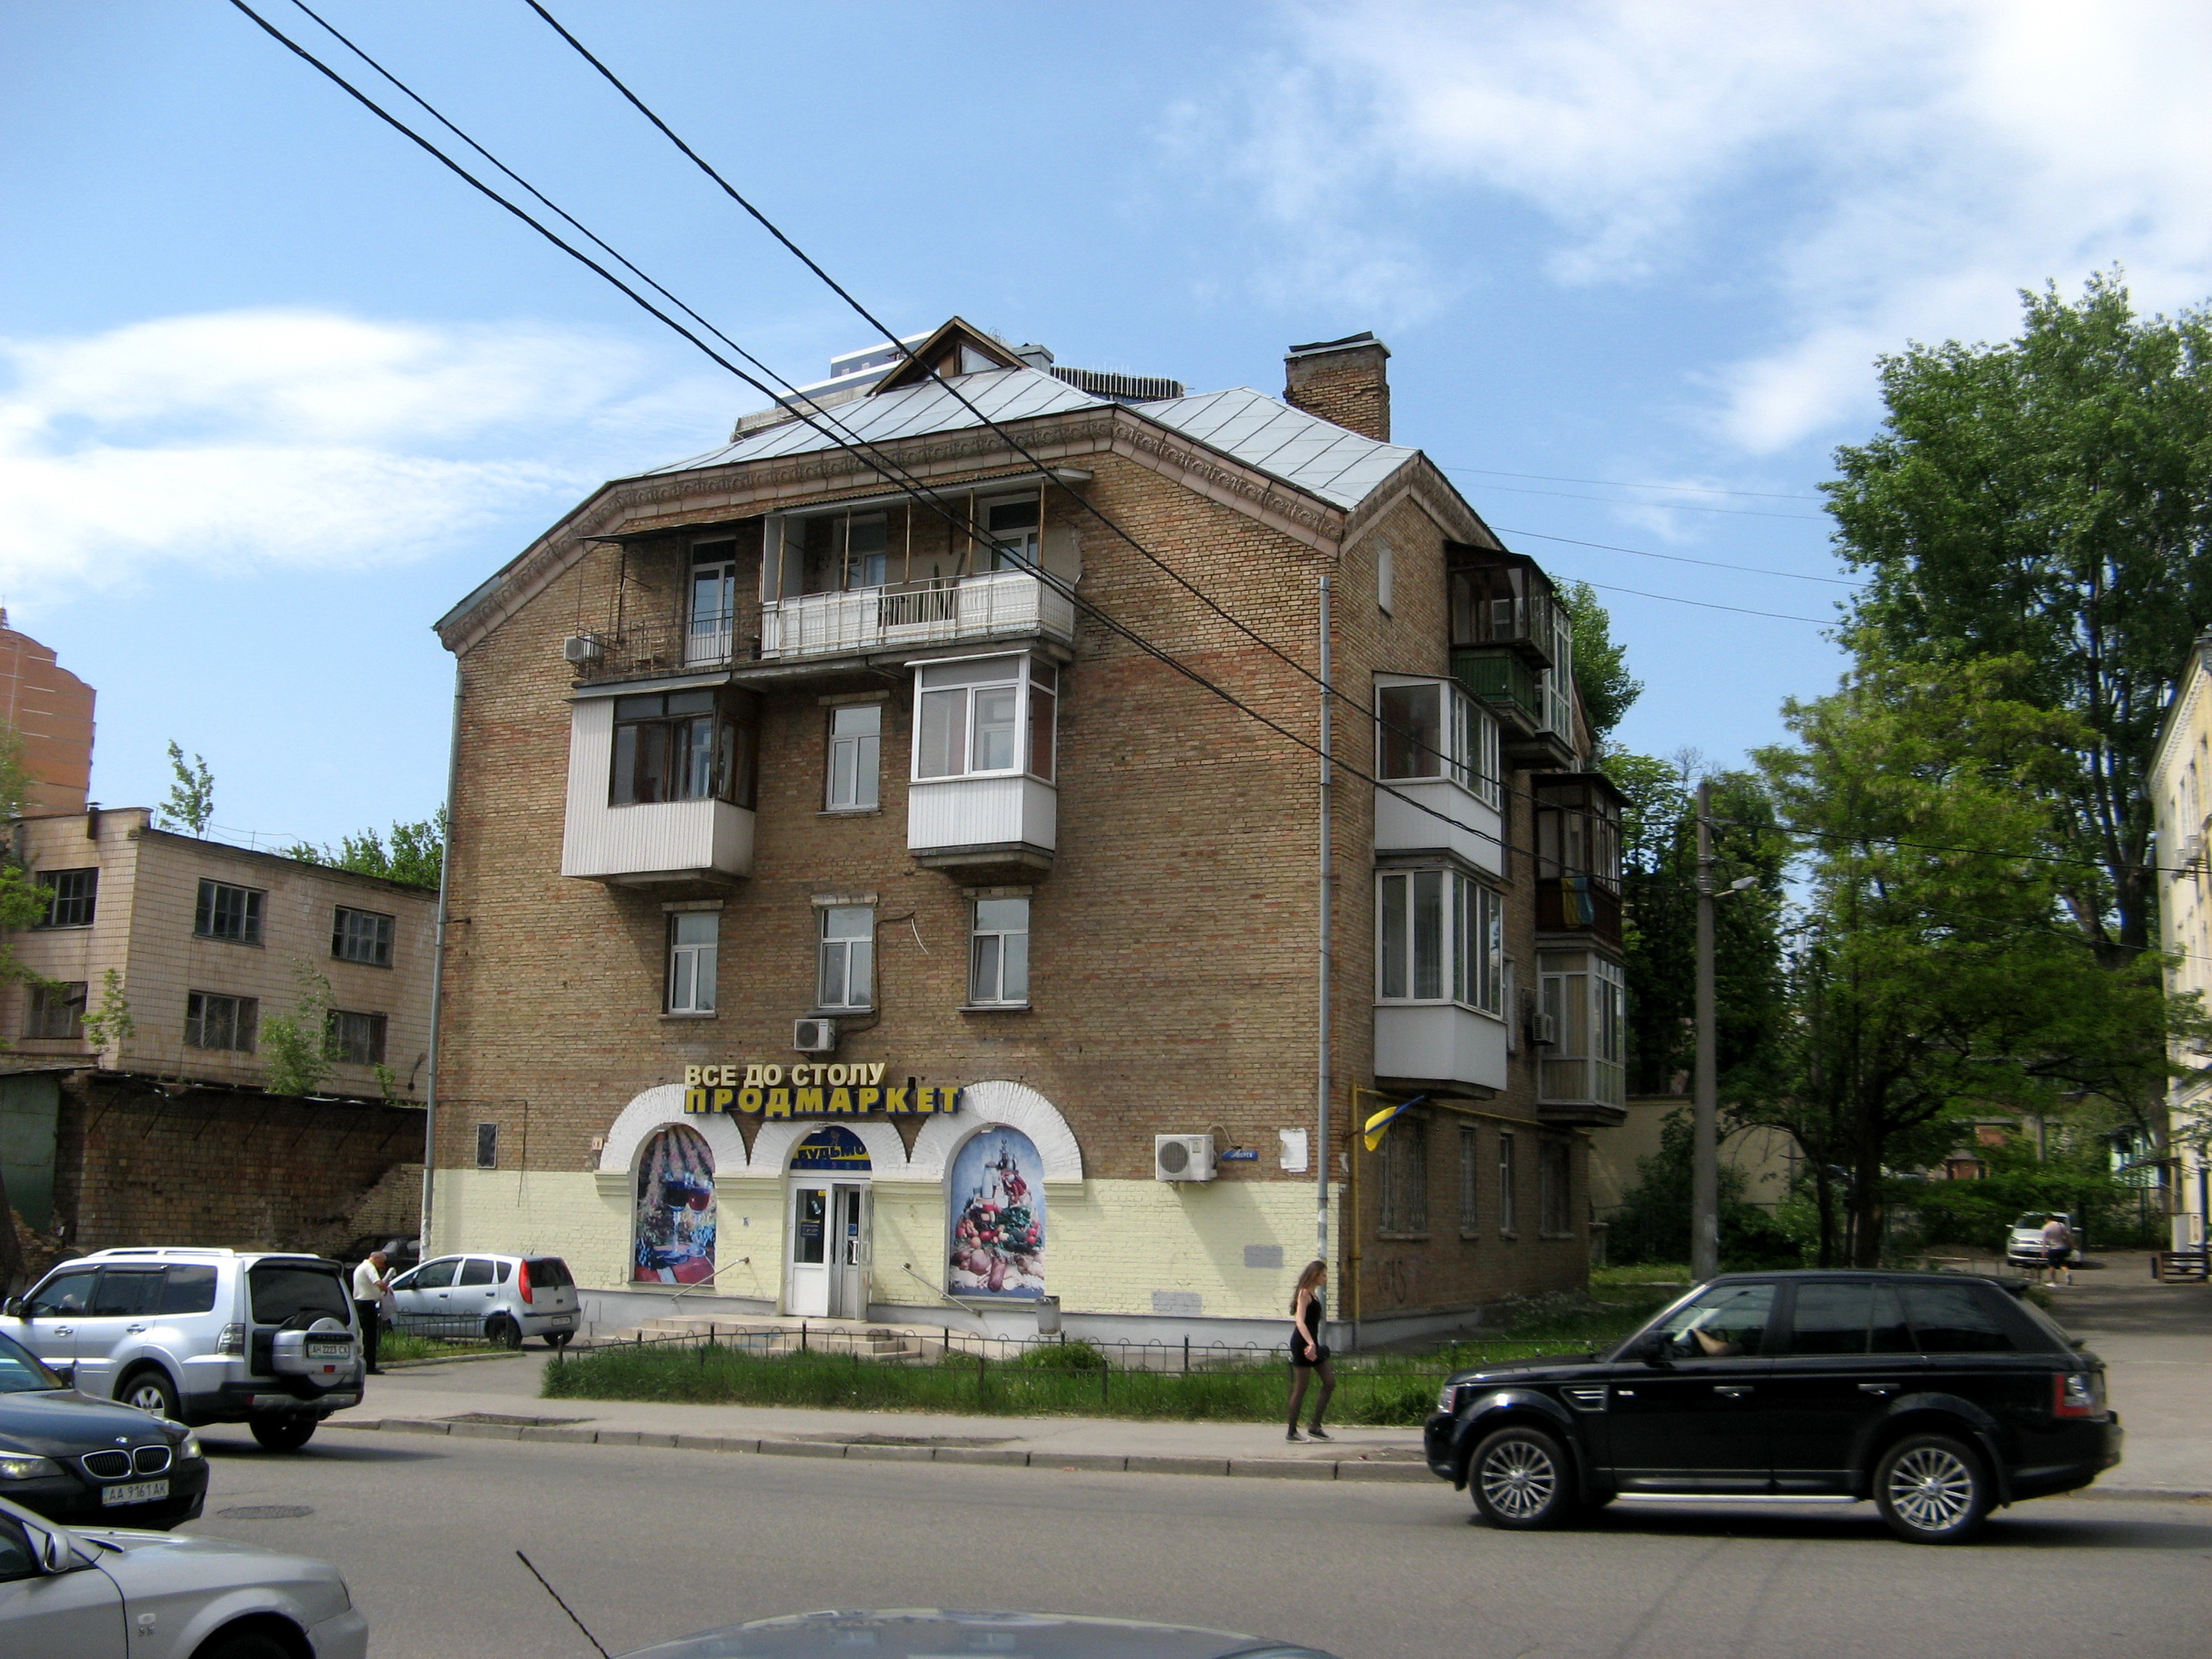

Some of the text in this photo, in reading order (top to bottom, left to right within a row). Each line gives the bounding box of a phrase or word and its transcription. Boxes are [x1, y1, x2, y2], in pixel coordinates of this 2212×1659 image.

[685, 1062, 886, 1089] ВСЕ ДО СТОЛУ
[684, 1087, 963, 1119] ПРОДМАРКЕТ
[110, 1487, 124, 1501] AA
[153, 1482, 167, 1495] AK
